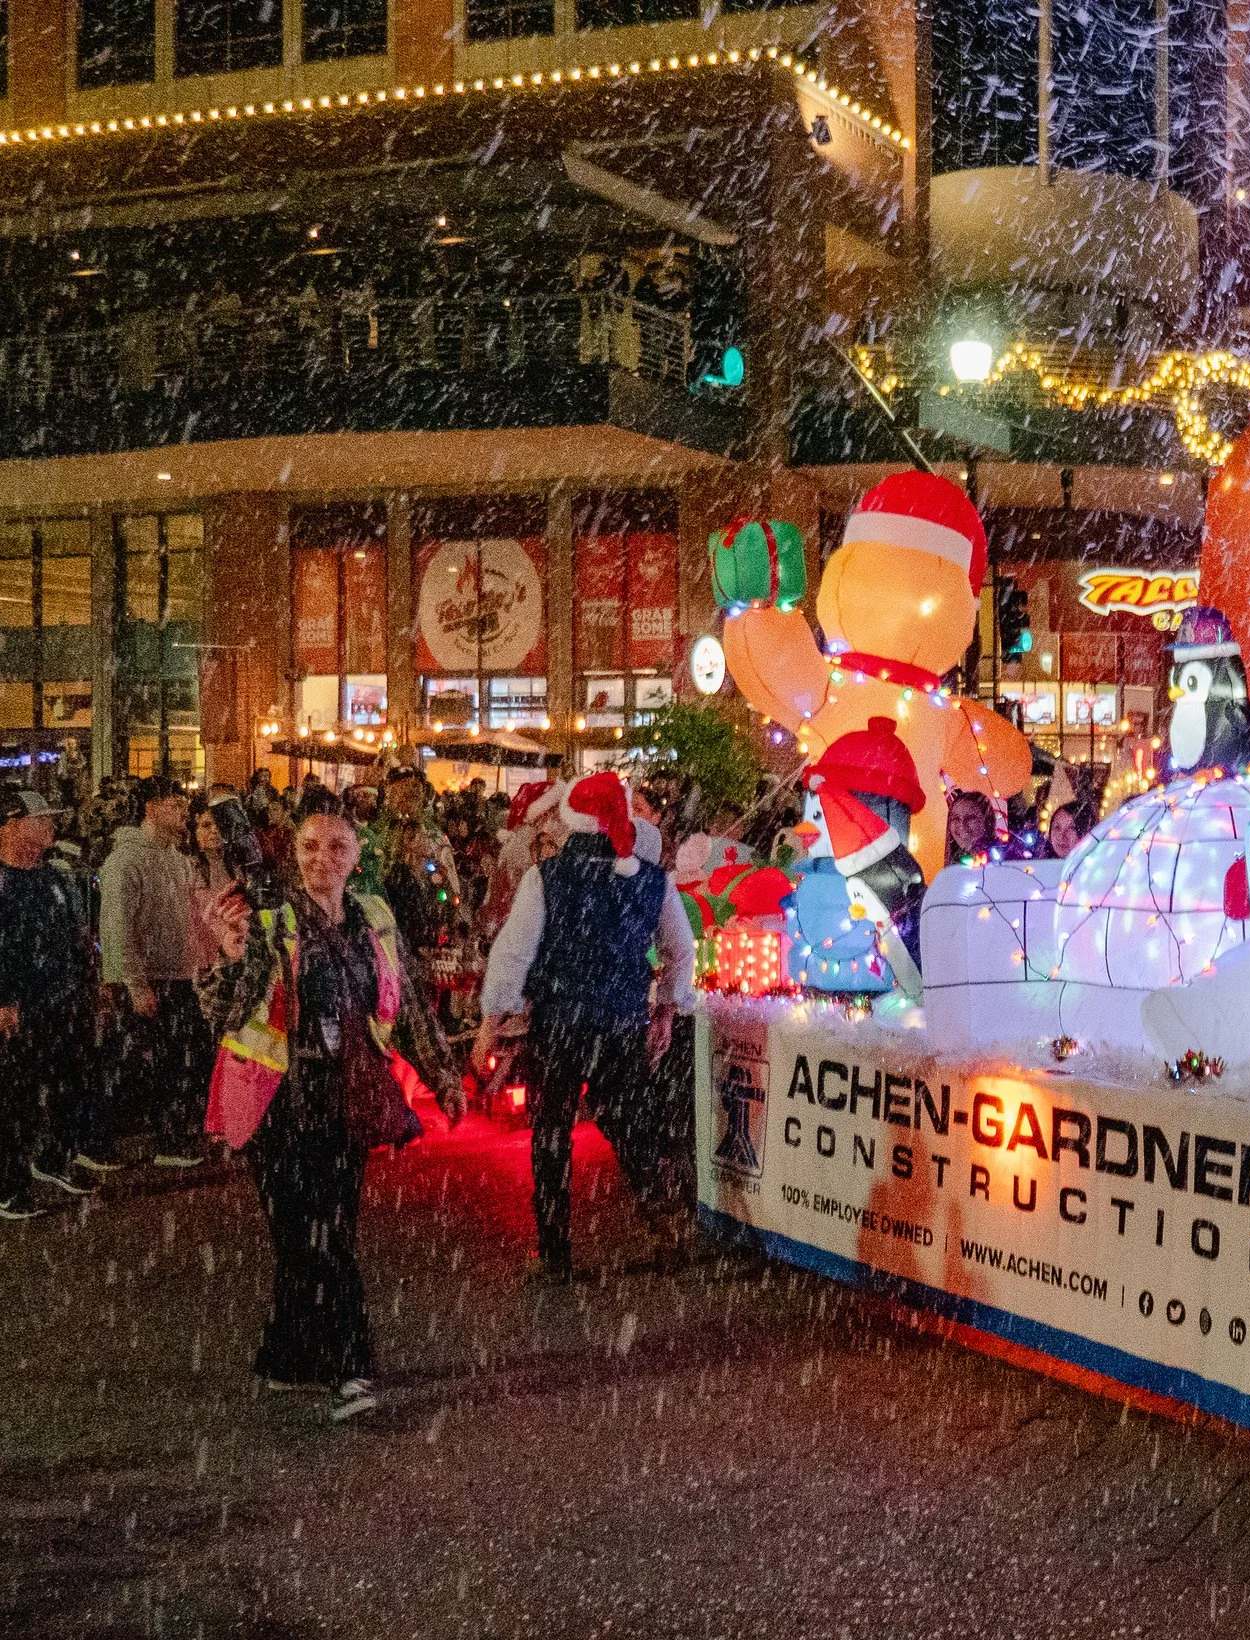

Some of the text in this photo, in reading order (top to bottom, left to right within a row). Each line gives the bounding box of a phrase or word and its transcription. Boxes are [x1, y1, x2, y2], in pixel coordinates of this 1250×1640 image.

[781, 1184, 1108, 1301] 100% EMPLOYEE OWNED WWW.ACHEN.COM
